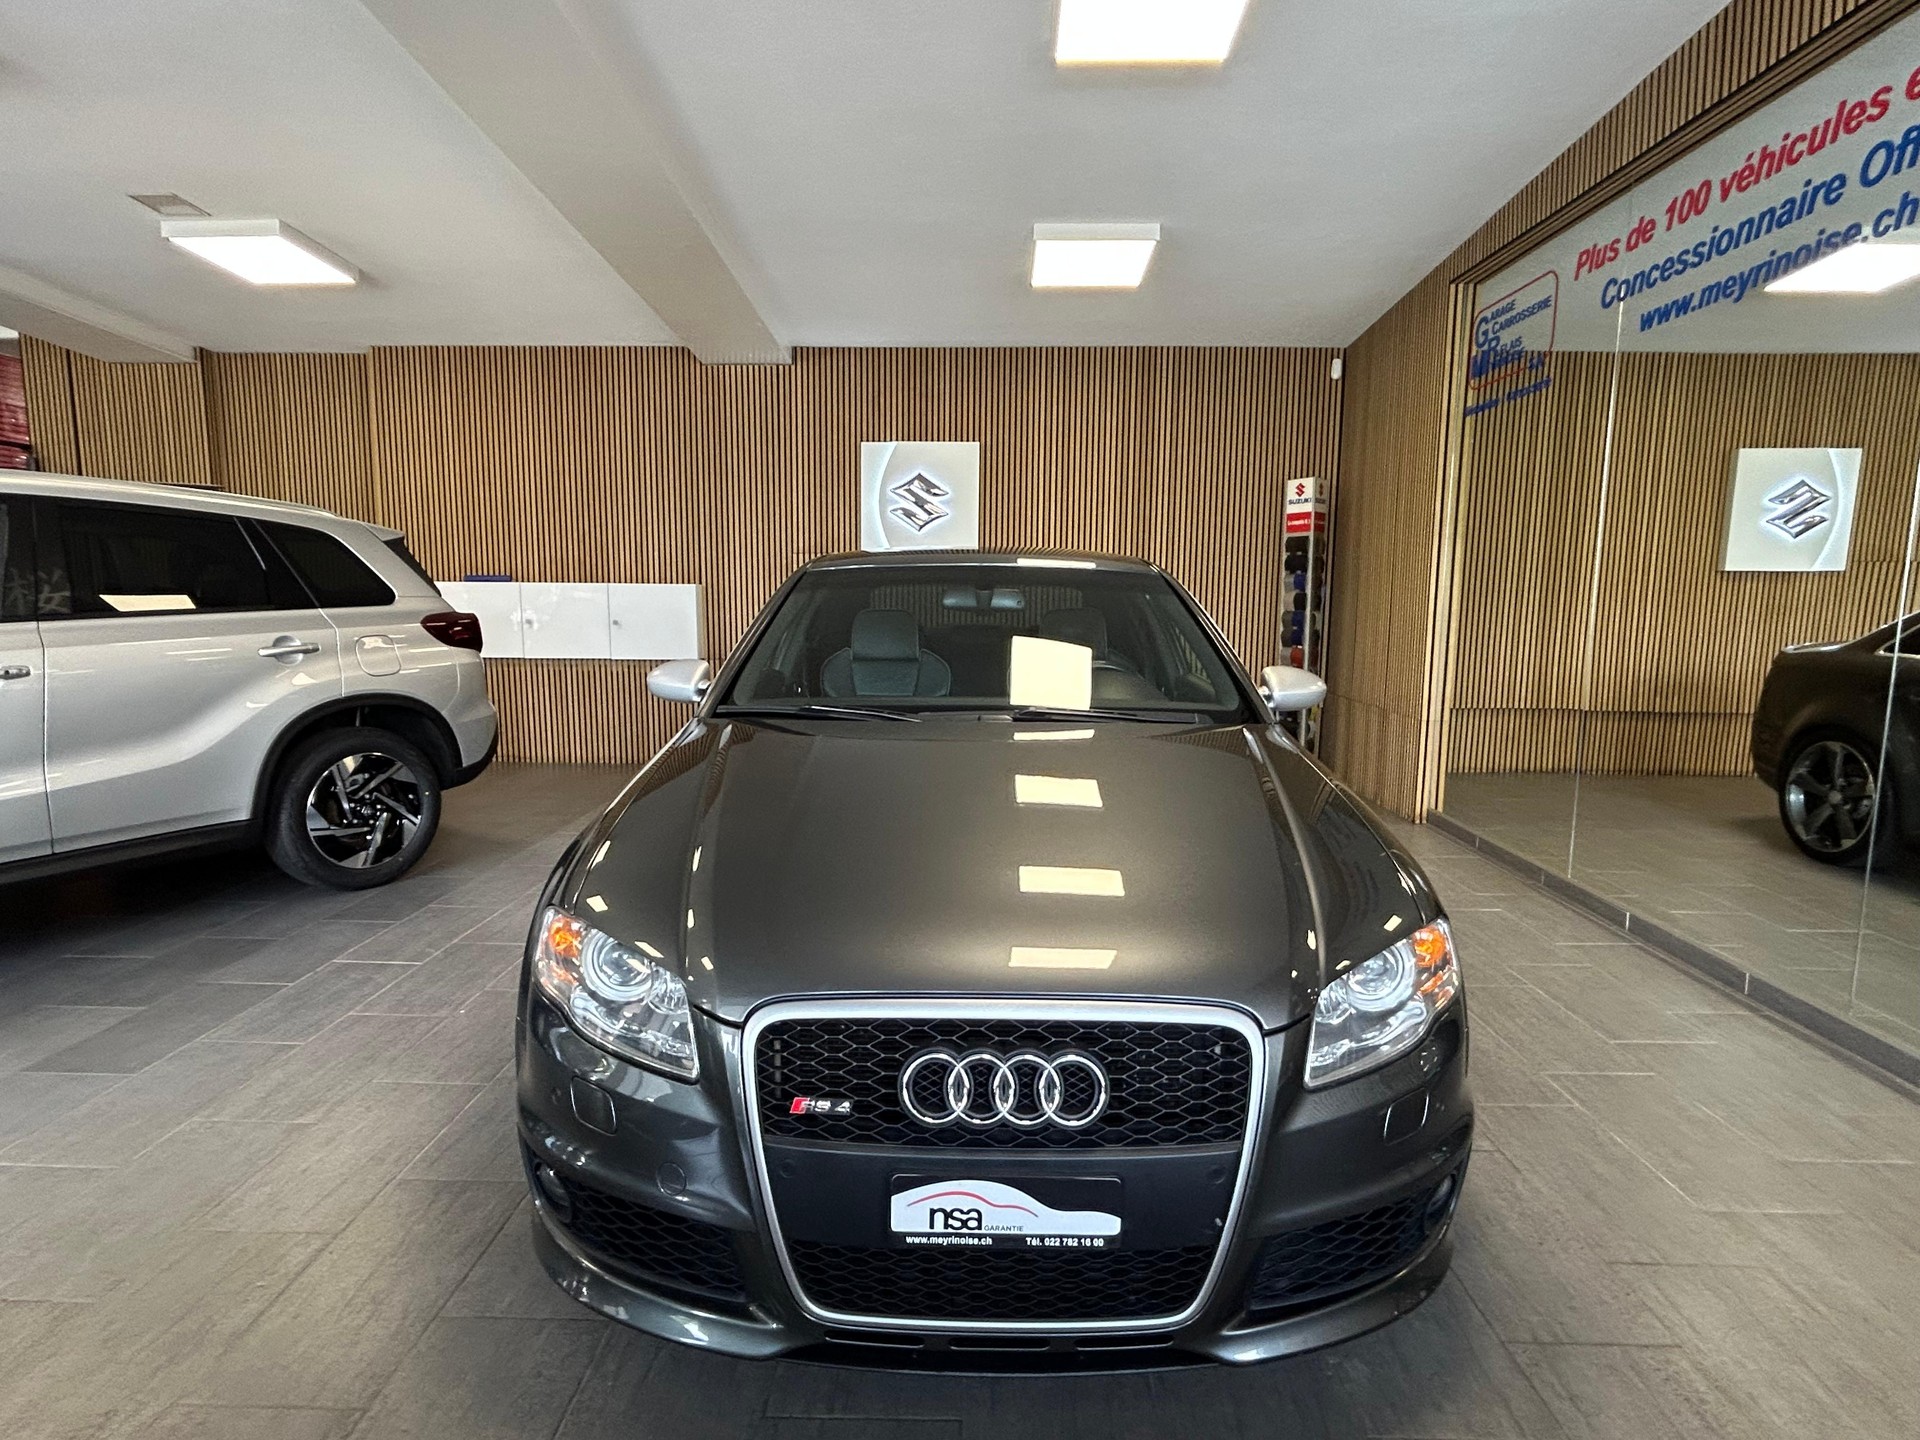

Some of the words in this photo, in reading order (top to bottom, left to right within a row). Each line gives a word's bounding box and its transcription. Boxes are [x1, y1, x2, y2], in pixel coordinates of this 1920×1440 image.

[1574, 237, 1621, 281] Plus
[1625, 215, 1656, 253] de
[1664, 179, 1712, 231] 100
[1719, 85, 1893, 202] véhicules
[1601, 172, 1847, 309] Concessionnaire
[905, 1235, 993, 1246] www.meyrinoise.ch
[1044, 1237, 1061, 1246] 022
[1062, 1237, 1079, 1247] 782
[1092, 1238, 1105, 1247] 00
[929, 1208, 983, 1231] nsa
